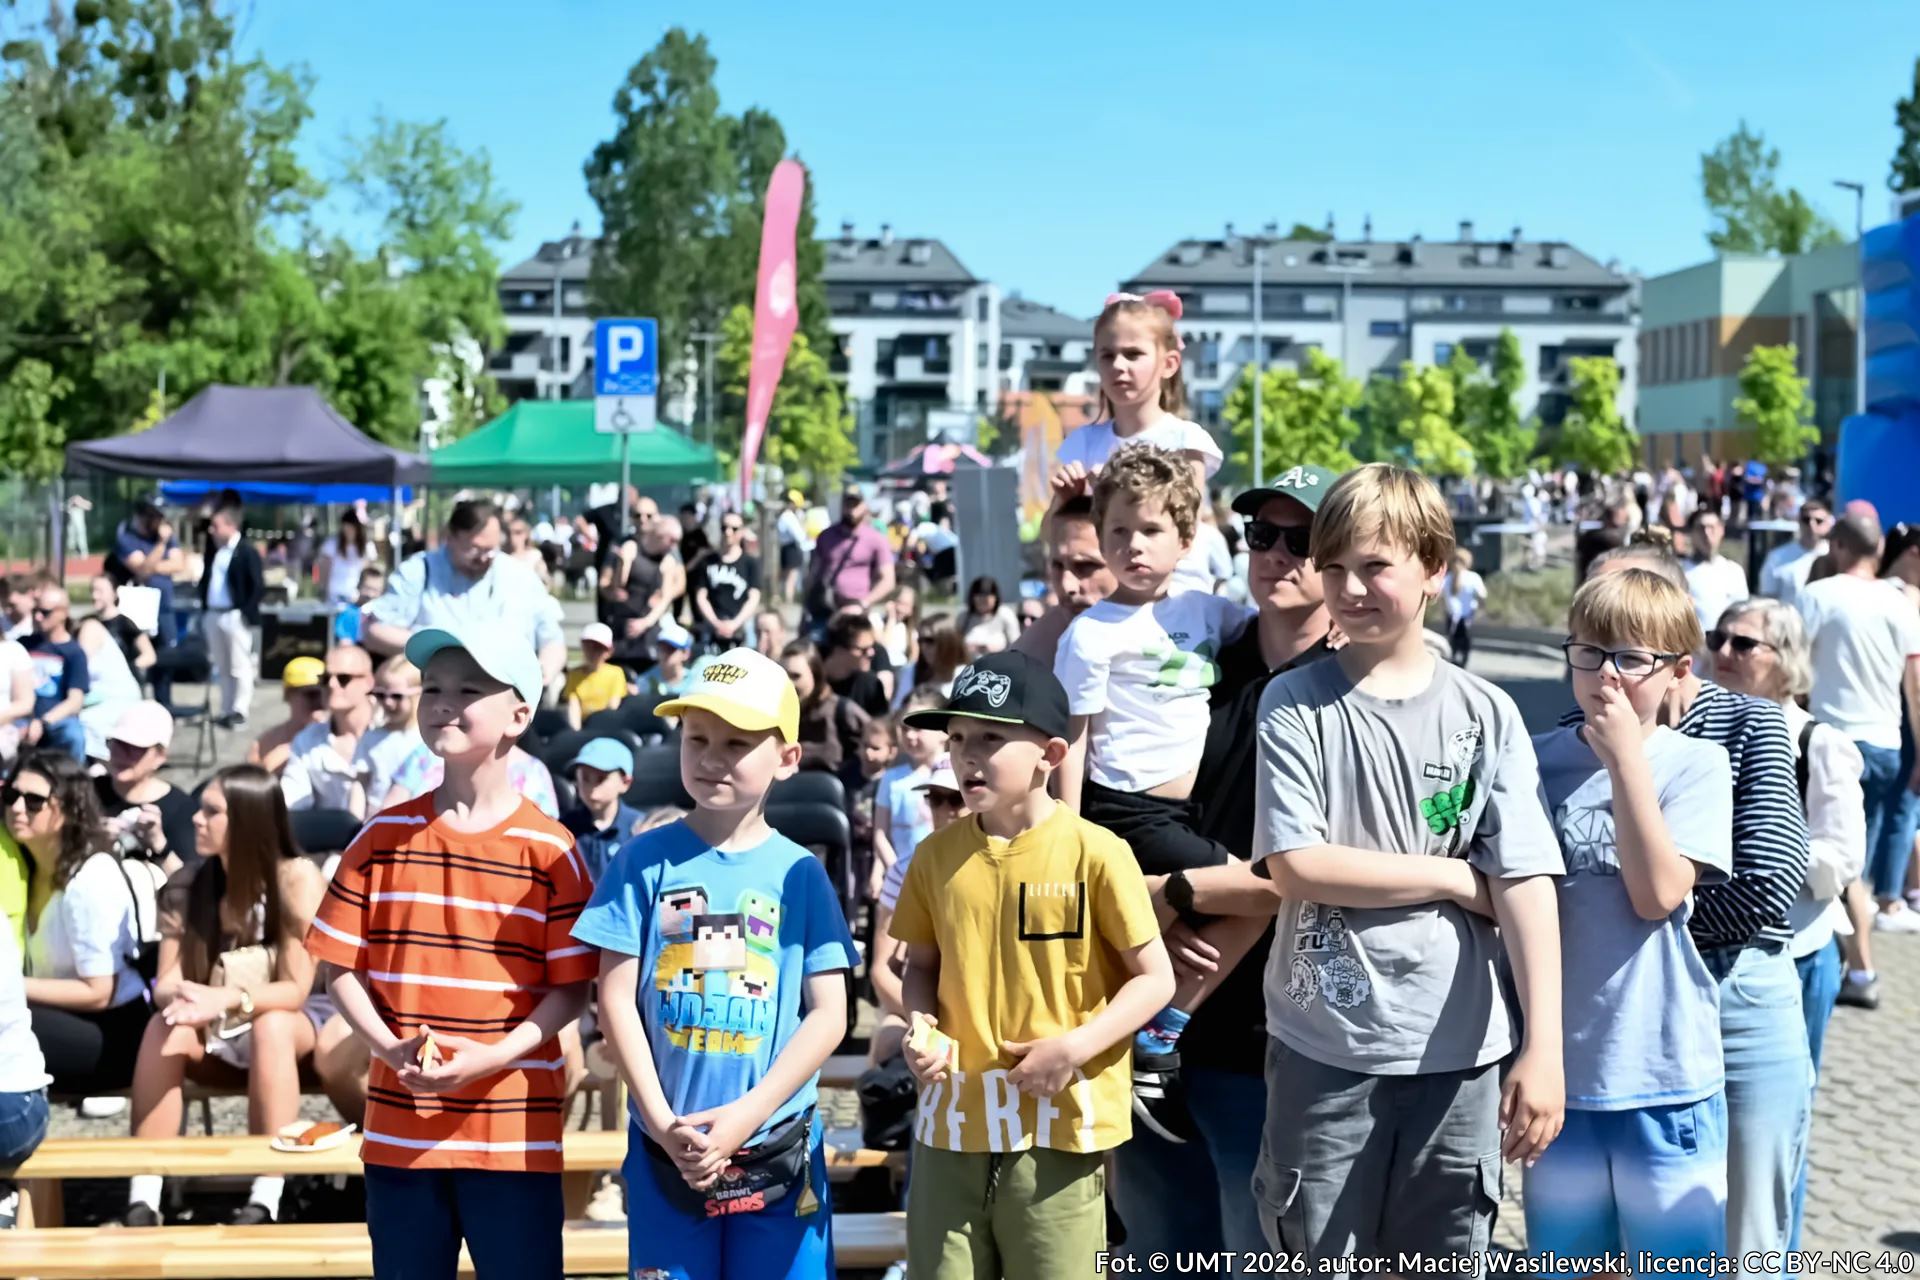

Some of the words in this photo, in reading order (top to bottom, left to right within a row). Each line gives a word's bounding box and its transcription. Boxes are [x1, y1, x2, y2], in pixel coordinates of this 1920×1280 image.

[608, 326, 644, 374] P
[655, 990, 773, 1034] WOJAN
[704, 1190, 766, 1217] STARS
[715, 1186, 753, 1201] BRAWL
